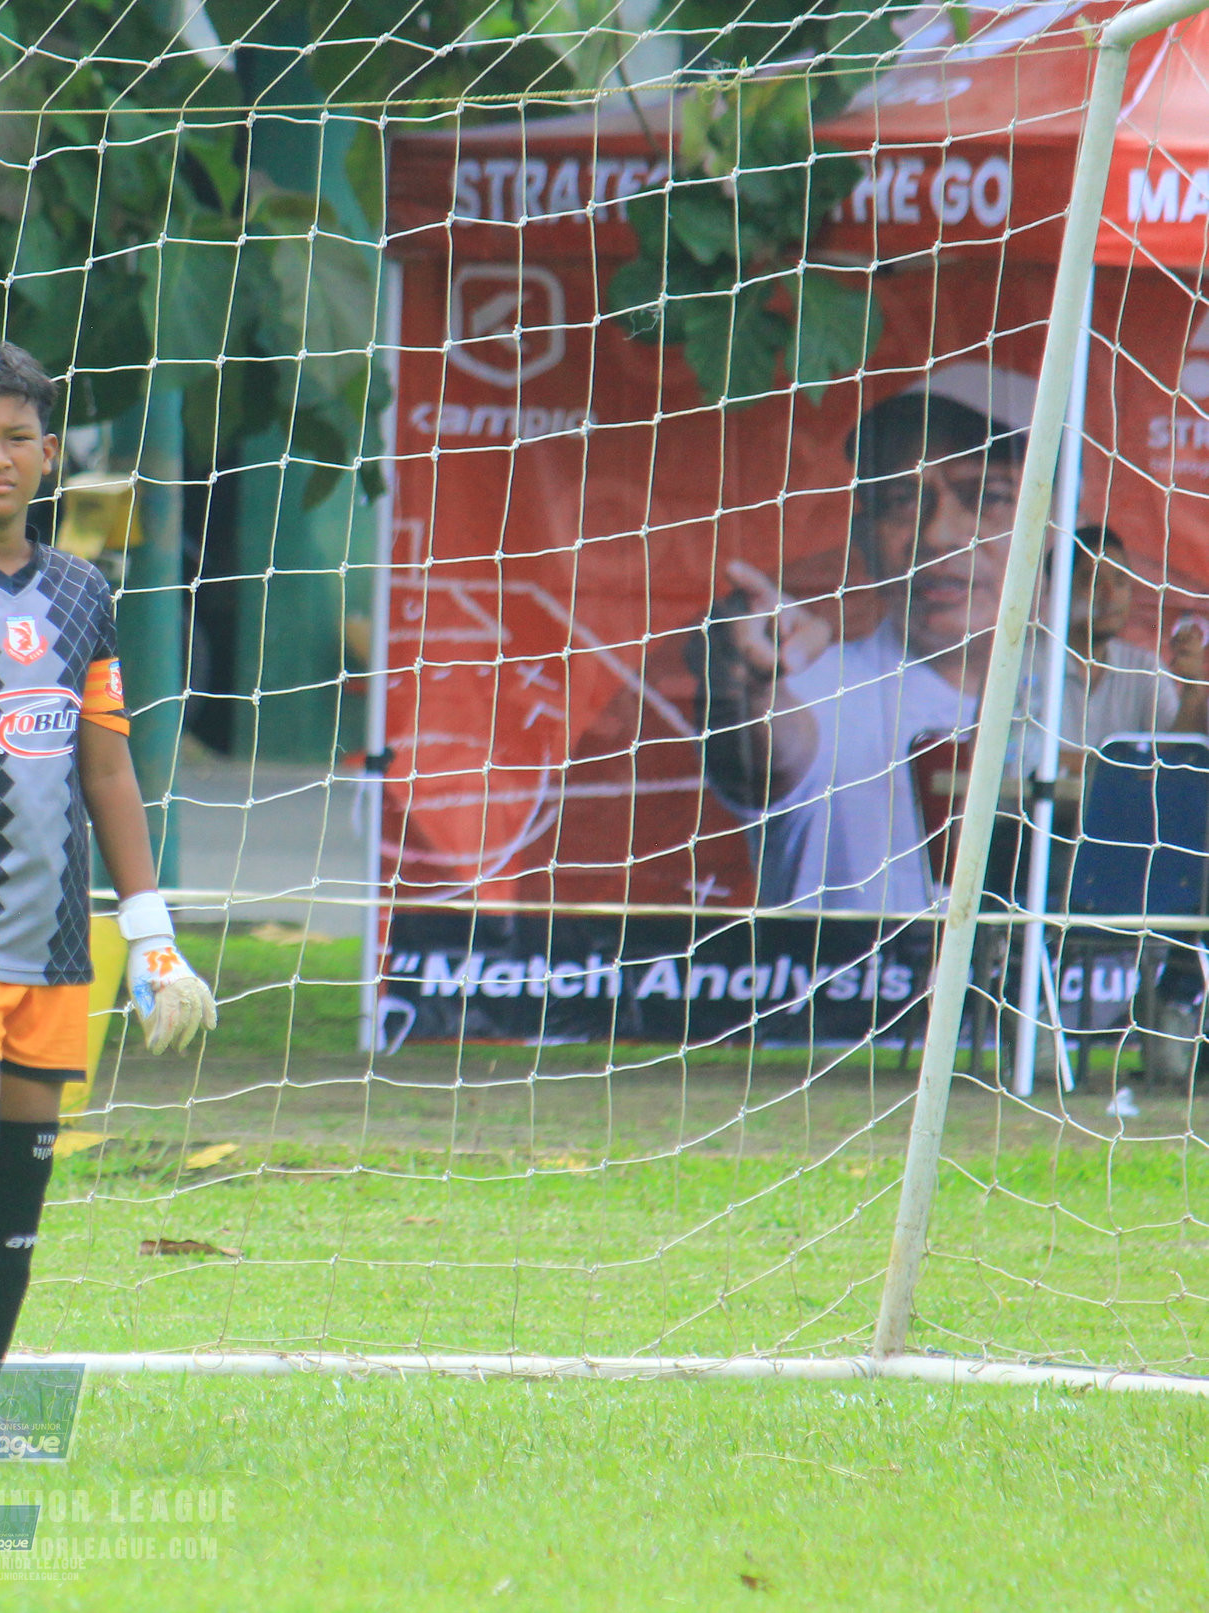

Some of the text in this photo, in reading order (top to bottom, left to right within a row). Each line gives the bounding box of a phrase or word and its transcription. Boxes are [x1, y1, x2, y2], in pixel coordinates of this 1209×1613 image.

[832, 156, 925, 225] HE
[929, 155, 1013, 228] GO
[635, 954, 913, 1015] Analysis
